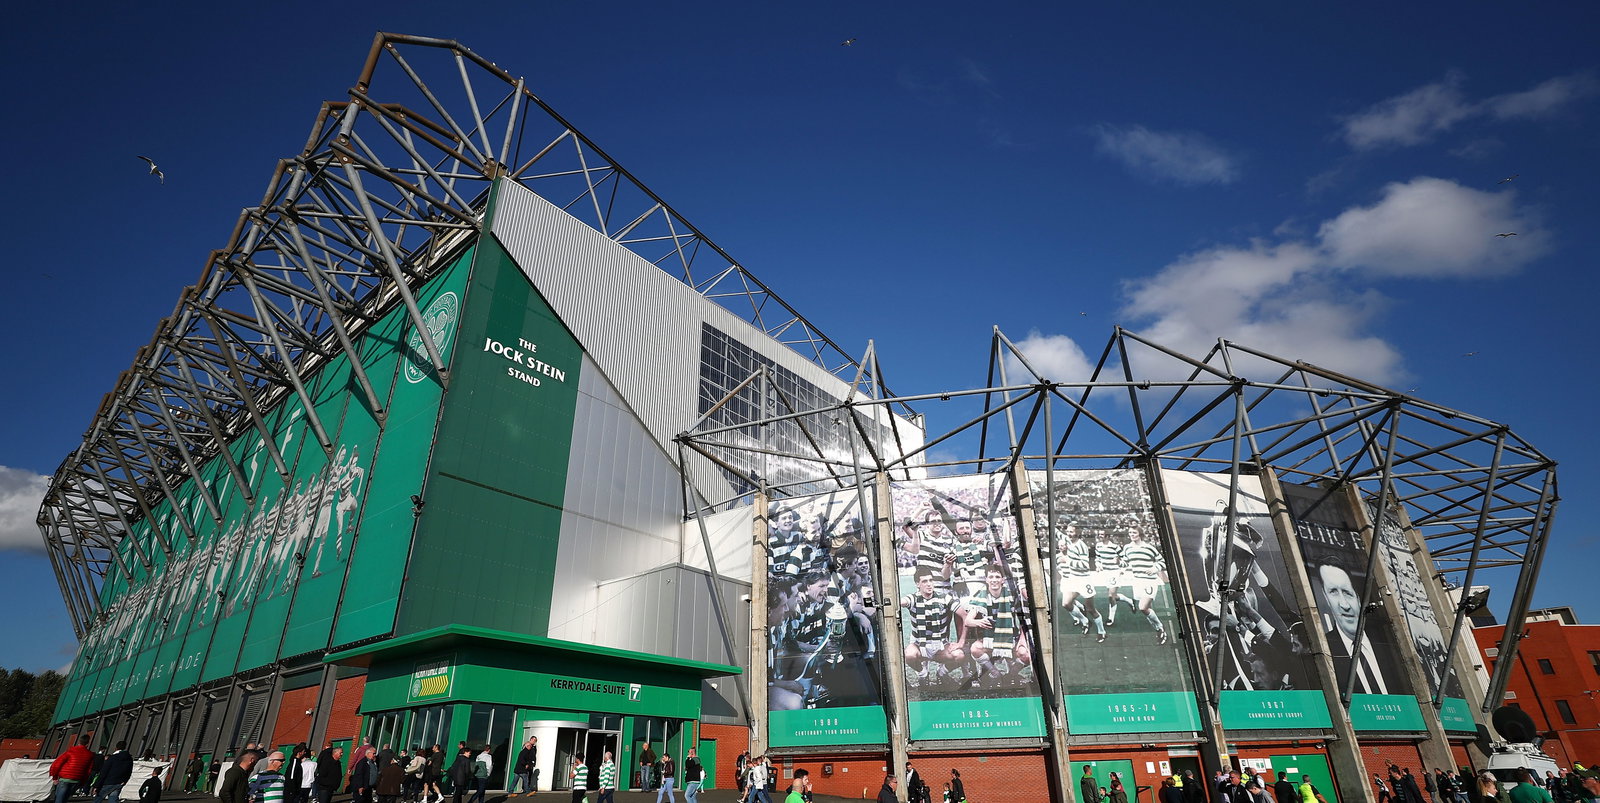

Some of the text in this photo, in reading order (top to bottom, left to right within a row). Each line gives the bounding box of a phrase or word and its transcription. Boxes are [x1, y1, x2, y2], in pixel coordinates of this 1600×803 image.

[518, 337, 537, 353] THE
[483, 337, 566, 383] JOCK STEIN
[507, 367, 541, 387] STAND
[144, 664, 165, 682] ARE
[167, 651, 201, 675] MADE
[550, 679, 626, 696] KERRYDALE SUITE
[631, 687, 640, 700] 7
[1261, 701, 1285, 709] 1967
[961, 710, 990, 719] 1985
[814, 718, 839, 727] 1988
[951, 721, 981, 729] SCOTTISH
